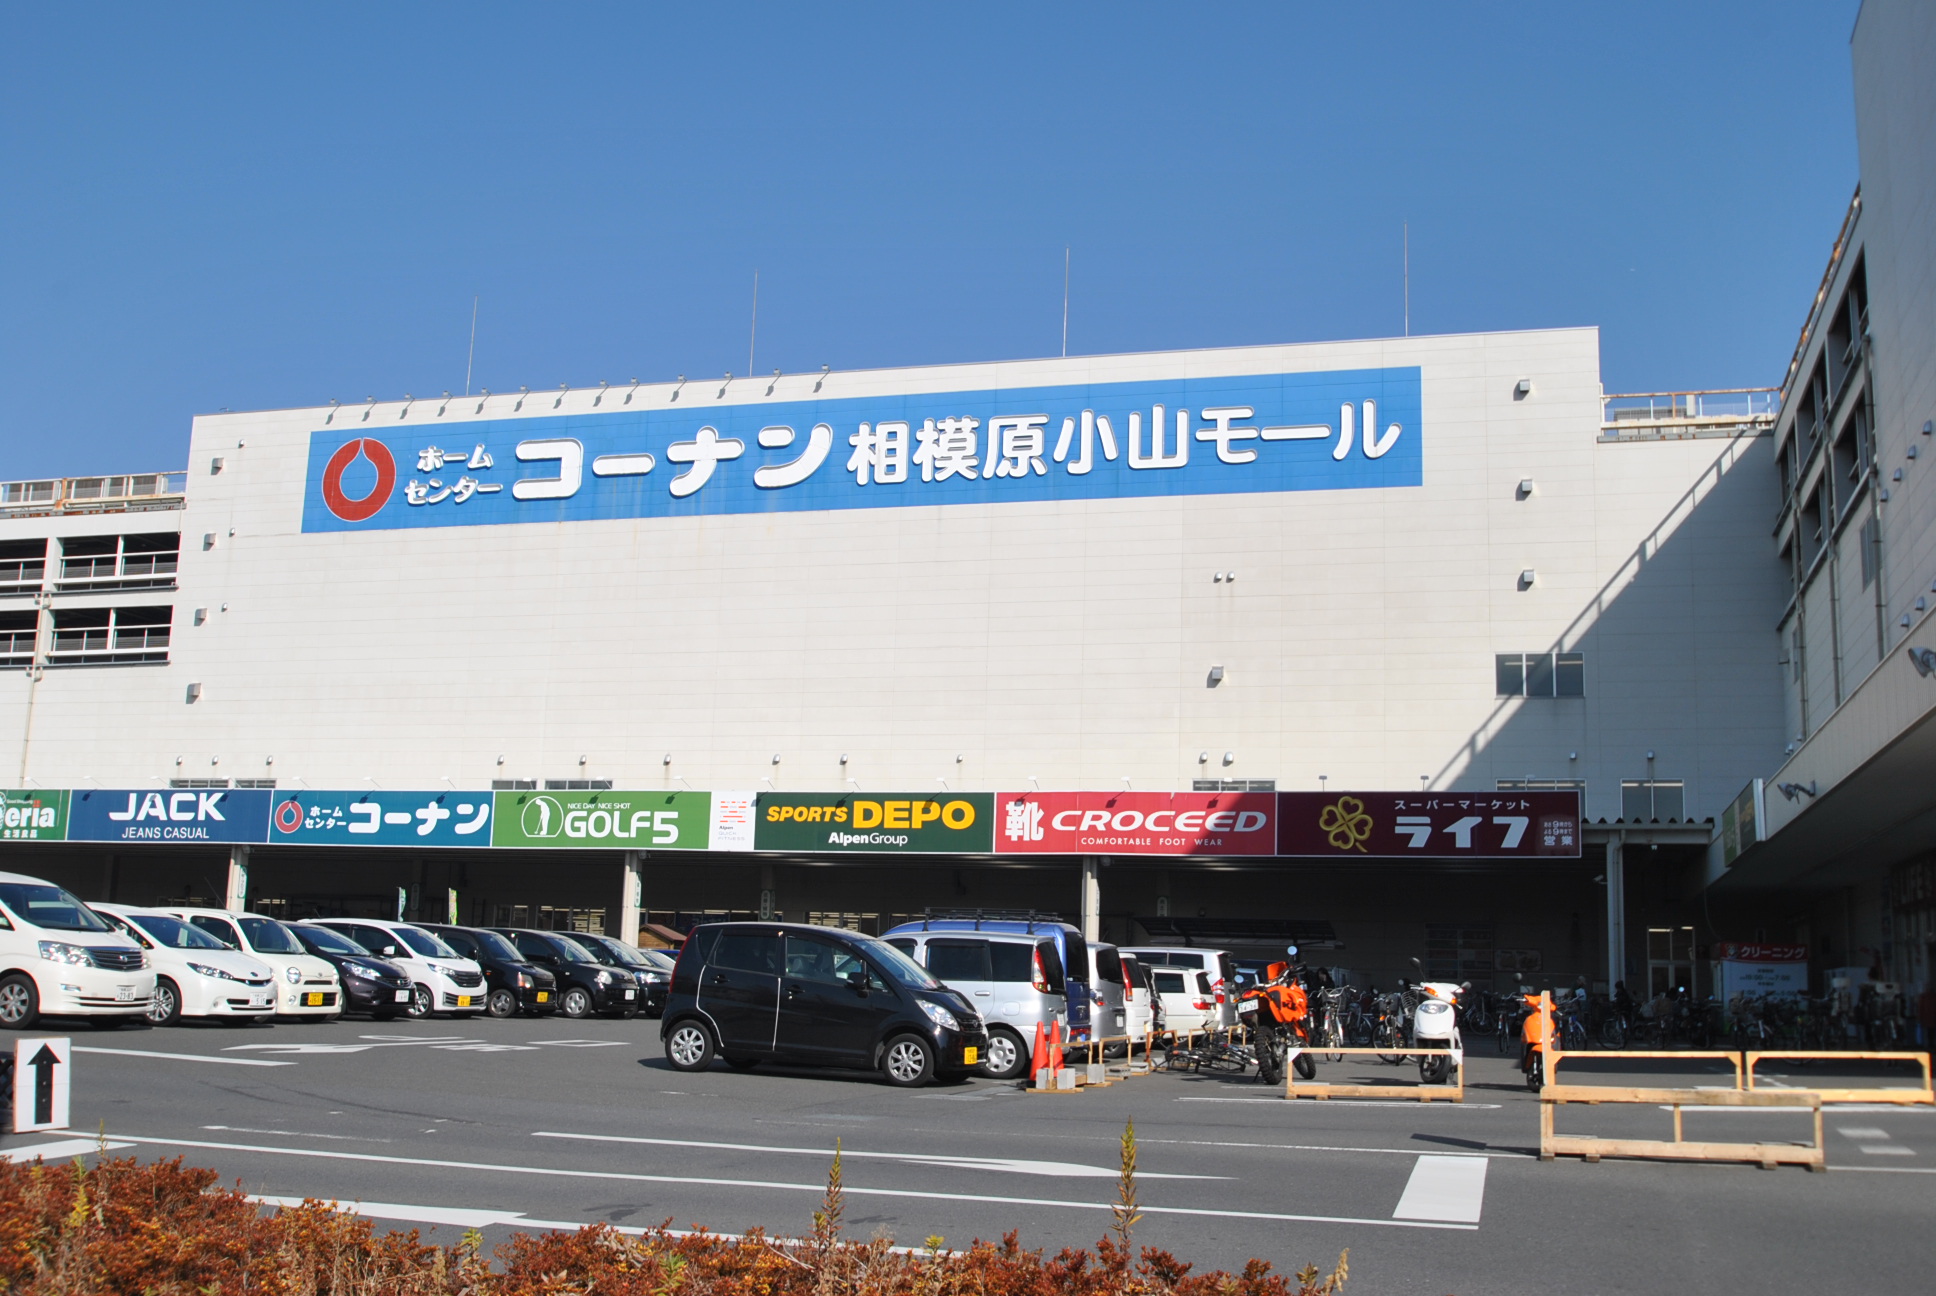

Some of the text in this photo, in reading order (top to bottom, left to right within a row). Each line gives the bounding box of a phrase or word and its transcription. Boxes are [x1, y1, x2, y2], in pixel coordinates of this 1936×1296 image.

[416, 442, 494, 473] ホーム
[404, 475, 504, 506] センター
[109, 792, 226, 821] JACK
[310, 806, 343, 817] ホーム
[348, 801, 490, 836] コーナン
[766, 800, 976, 830] SPORTS DEPO
[1394, 799, 1530, 810] スーパーマーケット
[122, 827, 210, 839] JEANS CASUAL
[304, 817, 347, 829] センター
[564, 811, 679, 844] GOLF5
[1005, 801, 1045, 841] 靴
[1051, 810, 1267, 832] CROCEED
[1394, 816, 1530, 848] ライフ
[1081, 837, 1222, 846] COMFORTABLE FOOT WEAR
[1740, 945, 1806, 959] クリーニング
